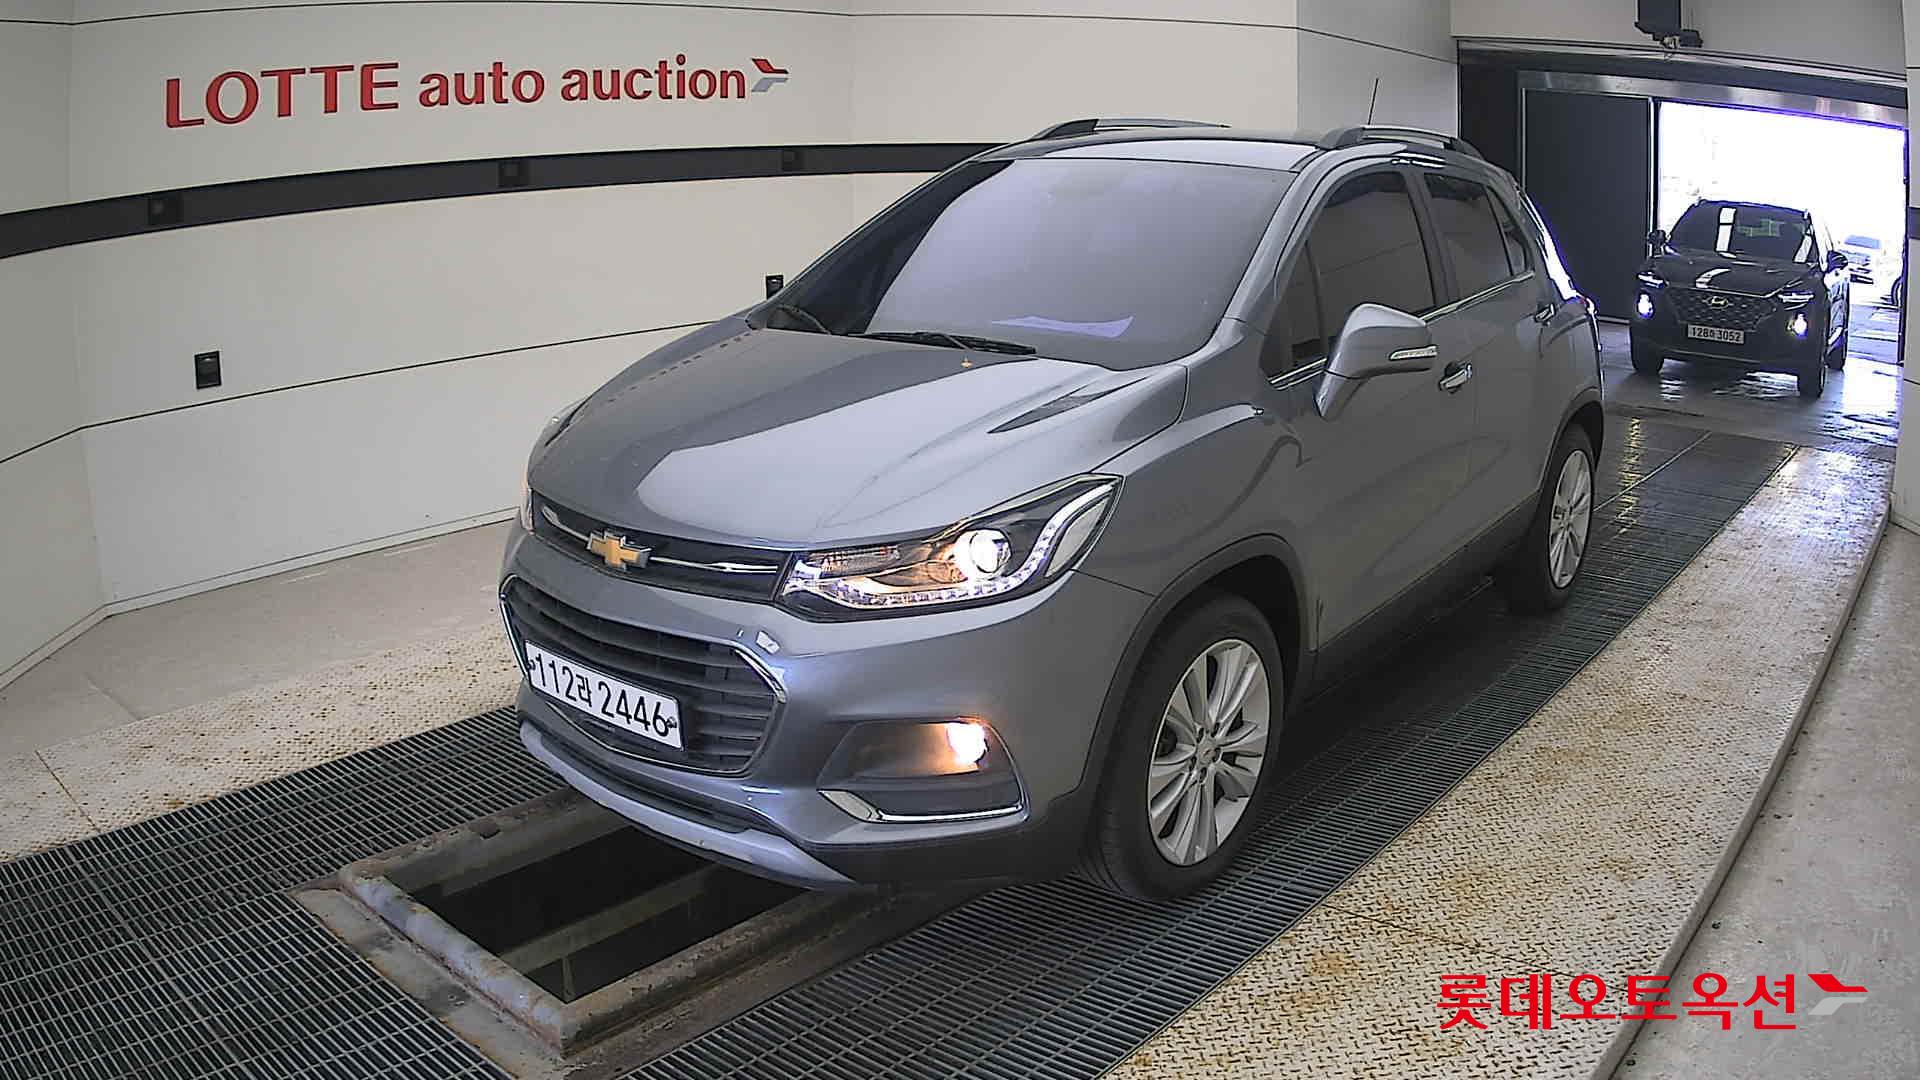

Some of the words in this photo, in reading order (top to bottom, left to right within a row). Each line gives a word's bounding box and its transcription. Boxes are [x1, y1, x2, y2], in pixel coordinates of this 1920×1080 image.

[164, 61, 399, 129] LOTTE
[418, 61, 545, 107] auto
[560, 53, 747, 101] auction
[535, 652, 592, 708] 112라
[597, 680, 671, 737] 2446
